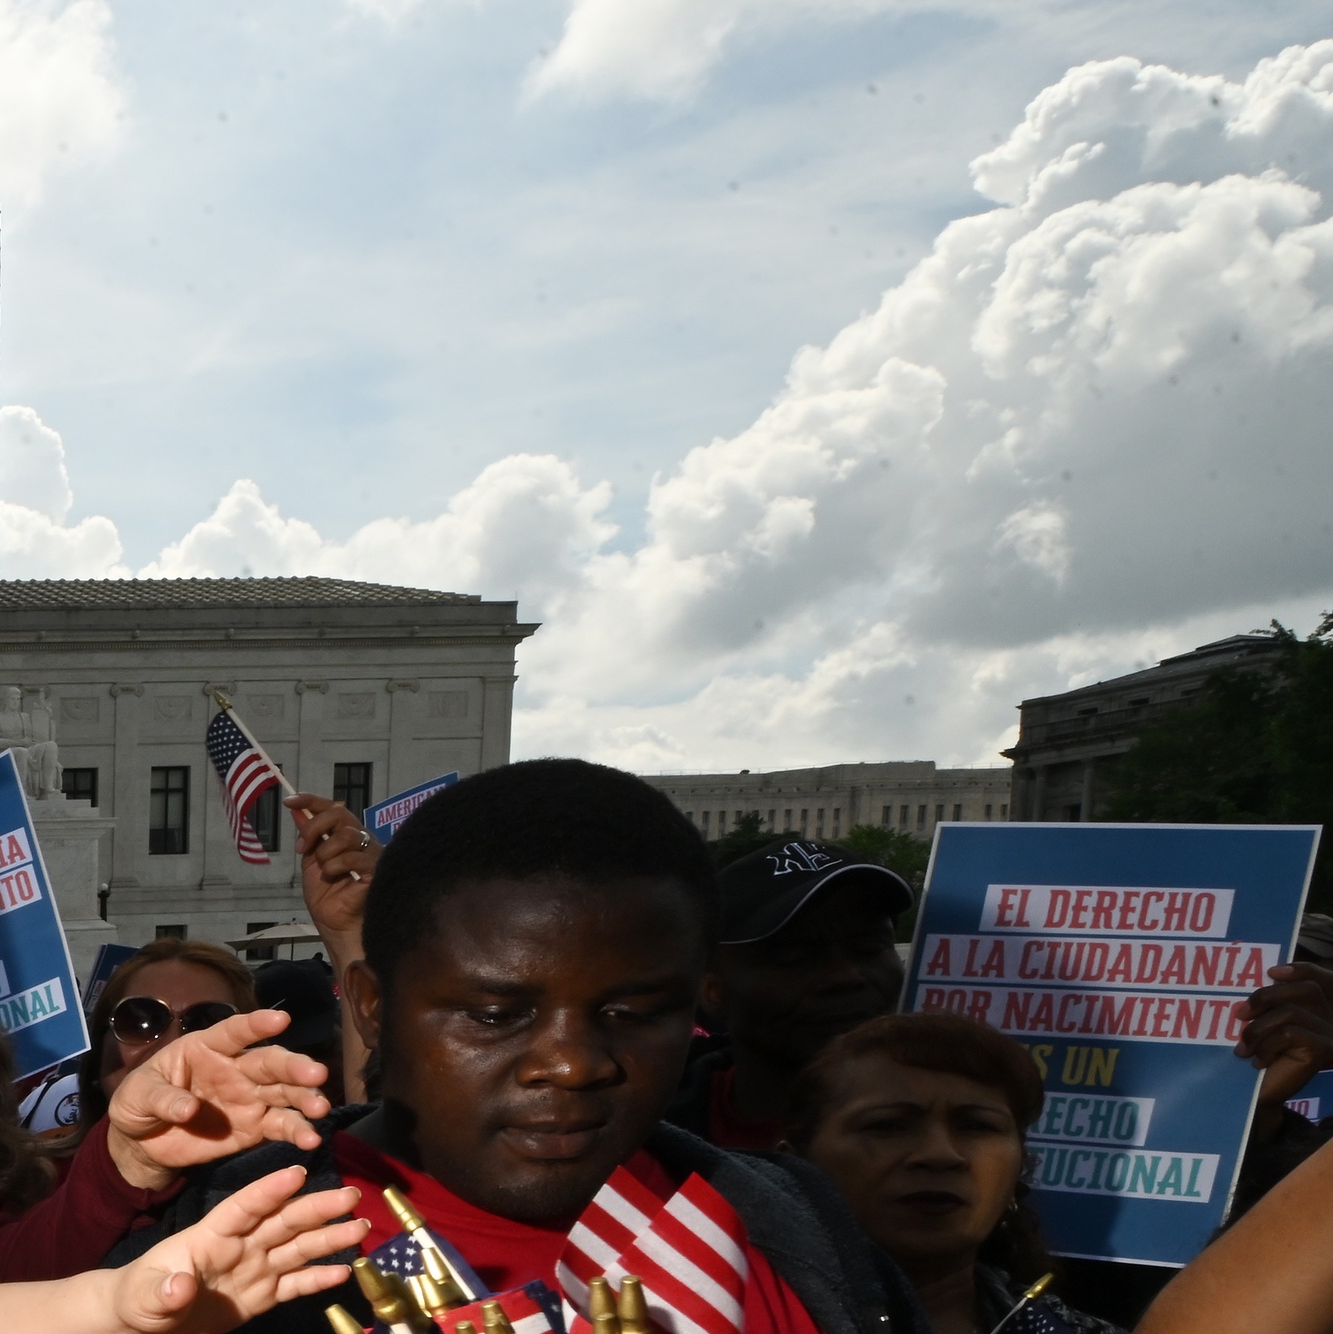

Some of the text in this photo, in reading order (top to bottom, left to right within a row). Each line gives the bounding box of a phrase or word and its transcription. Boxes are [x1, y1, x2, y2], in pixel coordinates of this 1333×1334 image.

[995, 888, 1215, 933] EL DERECHO
[926, 938, 1265, 988] A LA CIUDADANÍA
[1001, 991, 1250, 1042] NACIMIENTO
[1061, 1046, 1120, 1087] UN
